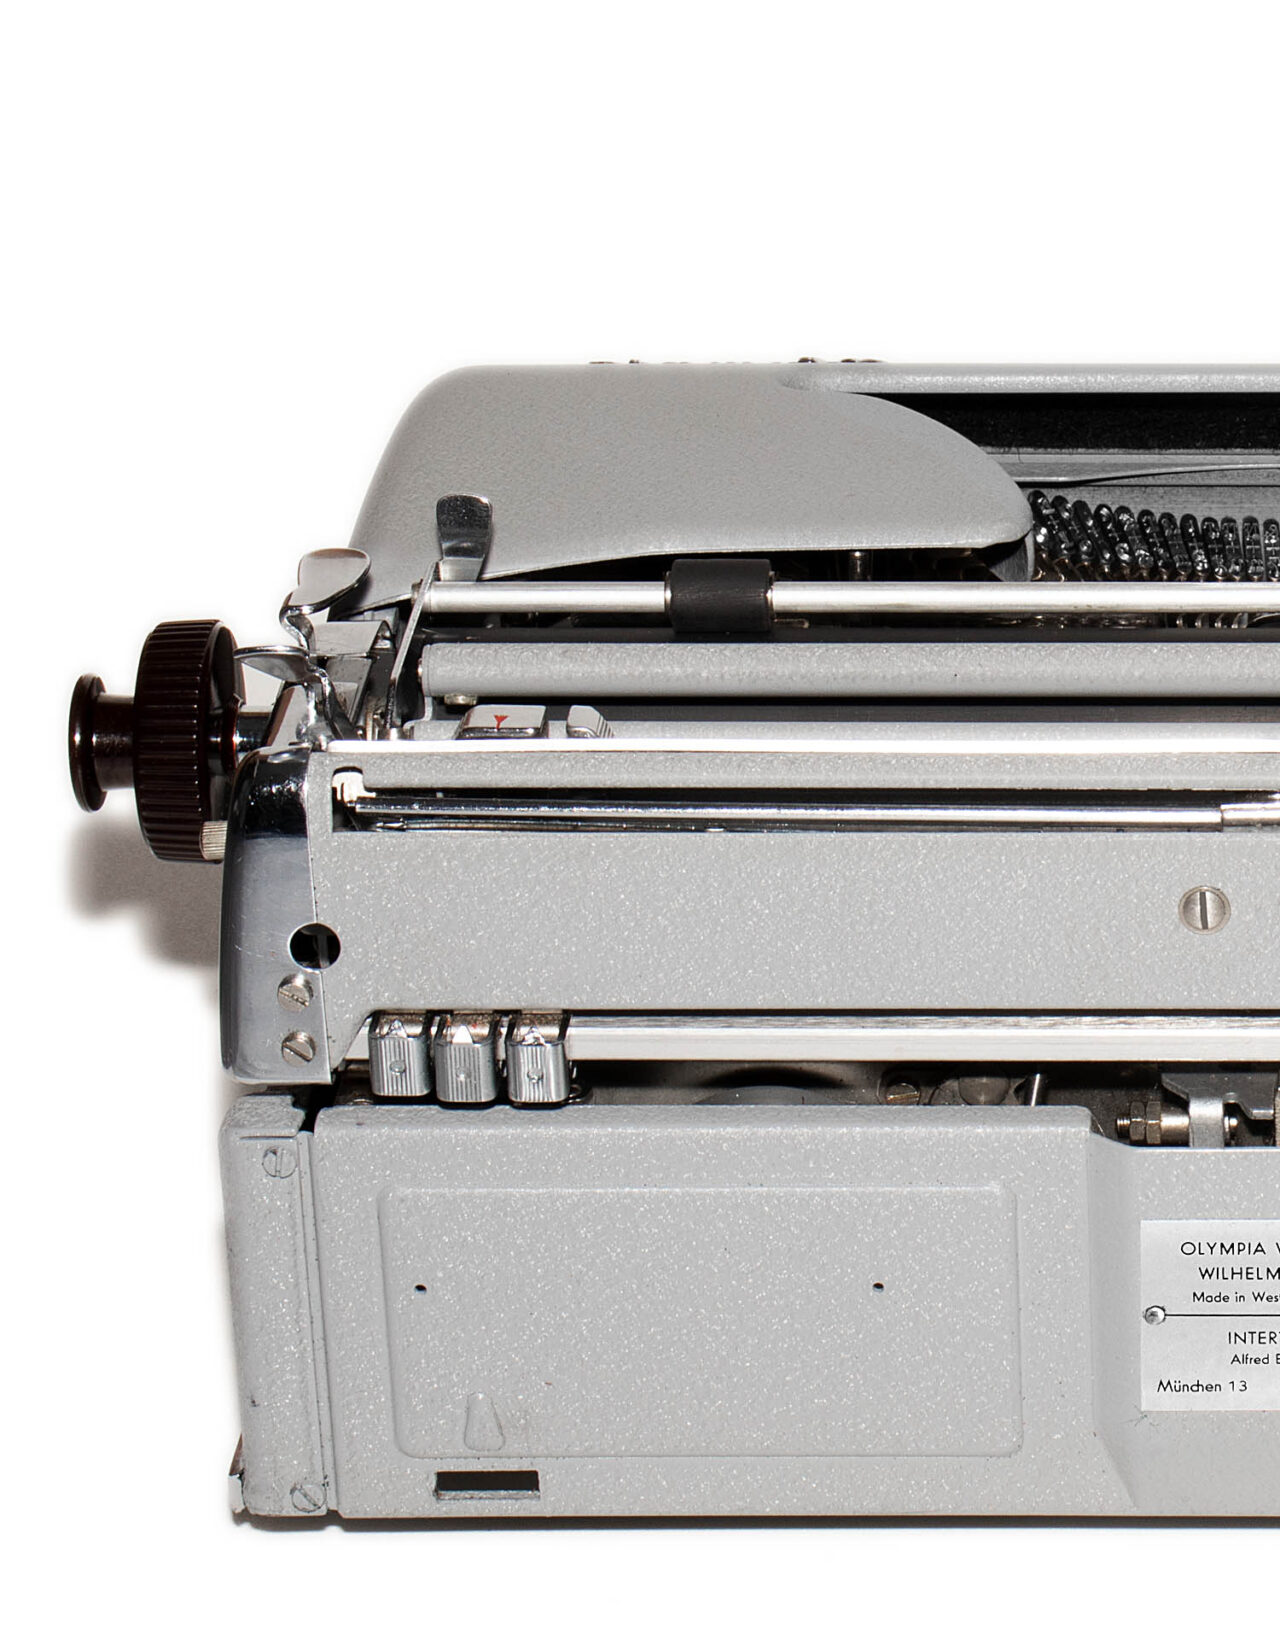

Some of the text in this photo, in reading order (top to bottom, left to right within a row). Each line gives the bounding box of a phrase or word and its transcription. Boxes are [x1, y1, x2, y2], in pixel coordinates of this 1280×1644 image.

[1180, 1241, 1267, 1256] OLYMPIA
[1192, 1291, 1230, 1303] Made
[1234, 1291, 1246, 1303] in
[1230, 1353, 1270, 1365] Alfred
[1156, 1379, 1248, 1393] München 13
